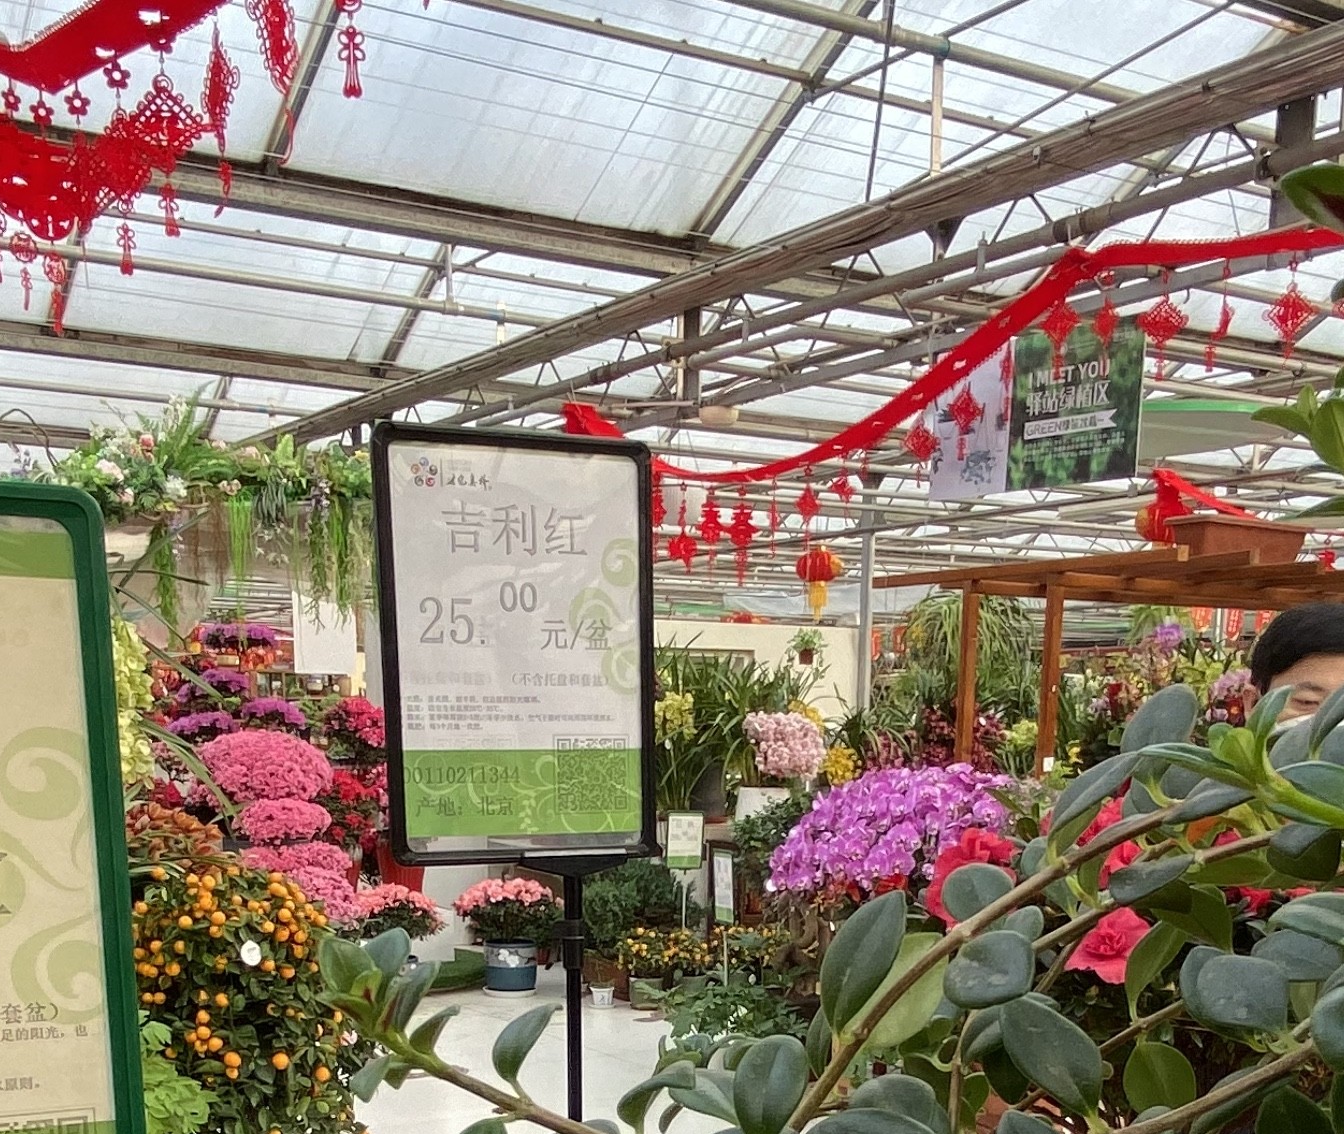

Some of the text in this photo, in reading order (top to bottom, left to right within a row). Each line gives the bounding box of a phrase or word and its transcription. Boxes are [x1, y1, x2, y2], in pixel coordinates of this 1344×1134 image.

[440, 500, 588, 557] 吉利红
[540, 618, 613, 651] 元/盆
